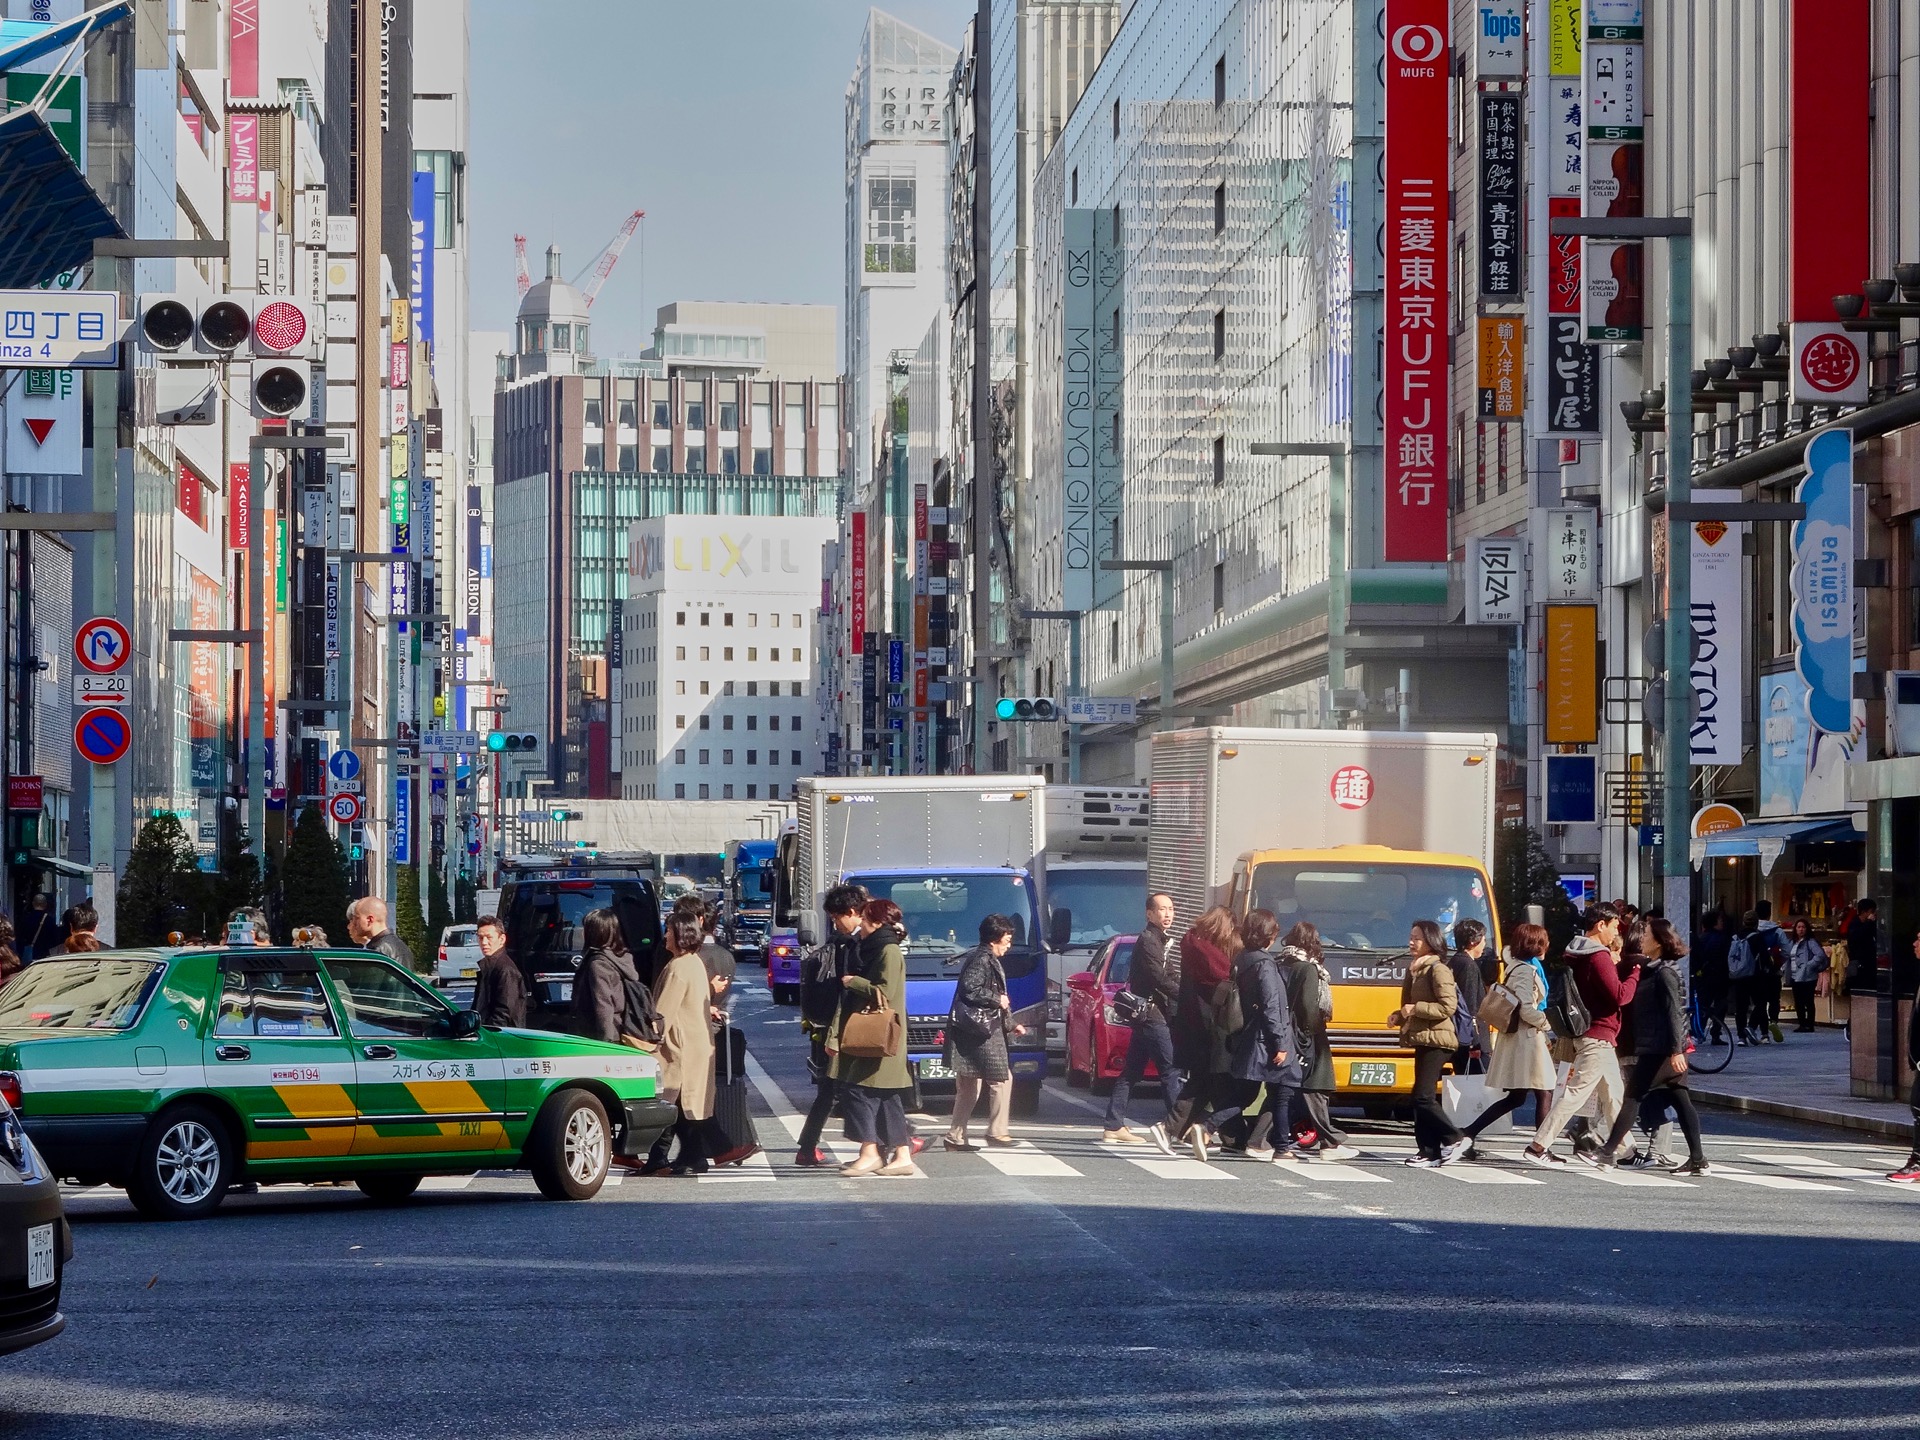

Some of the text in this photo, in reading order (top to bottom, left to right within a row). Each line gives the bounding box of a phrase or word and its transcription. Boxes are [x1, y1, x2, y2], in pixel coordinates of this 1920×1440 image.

[1481, 9, 1520, 43] Tops
[1604, 28, 1627, 39] 6F
[1488, 50, 1513, 58] ケーキ
[1554, 15, 1562, 69] GALLERY
[1400, 67, 1435, 78] MUFG
[1625, 47, 1633, 78] EYE
[1560, 88, 1581, 99] 築
[1625, 83, 1633, 123] PLUS
[1485, 101, 1499, 160] 中国料理
[1605, 128, 1628, 139] 5F
[233, 119, 256, 199] プレミア証券
[311, 194, 321, 240] 井上商会
[1488, 202, 1511, 291] 青百合飯荘
[6, 311, 104, 340] 四丁目
[1604, 328, 1628, 339] 3F
[40, 342, 51, 358] 4
[1399, 179, 1435, 506] 三菱東京UFJ銀行
[1497, 322, 1514, 412] 輸入洋食器
[1554, 320, 1581, 429] コーヒー屋
[1485, 389, 1494, 413] 4F
[239, 484, 248, 545] AACクリニック
[629, 533, 665, 581] LIXIL
[674, 533, 800, 578] LIXIL
[468, 568, 479, 616] ALBION
[1564, 589, 1576, 597] 1F
[1810, 561, 1818, 604] GINZA
[328, 588, 337, 619] 50分
[854, 567, 864, 633] 銀座アスター
[456, 643, 464, 679] MZUHO
[1072, 704, 1131, 714] 銀座三丁目
[423, 736, 475, 746] 銀座三丁目
[11, 781, 41, 789] BOOKS
[1334, 770, 1372, 806] 通
[336, 802, 354, 815] 50
[1114, 804, 1137, 812] Topre
[1342, 966, 1407, 980] ISUZU
[292, 1068, 319, 1080] 6194
[392, 1064, 423, 1079] スガイ
[1359, 1071, 1395, 1083] 77-63
[459, 1122, 482, 1136] TAXI
